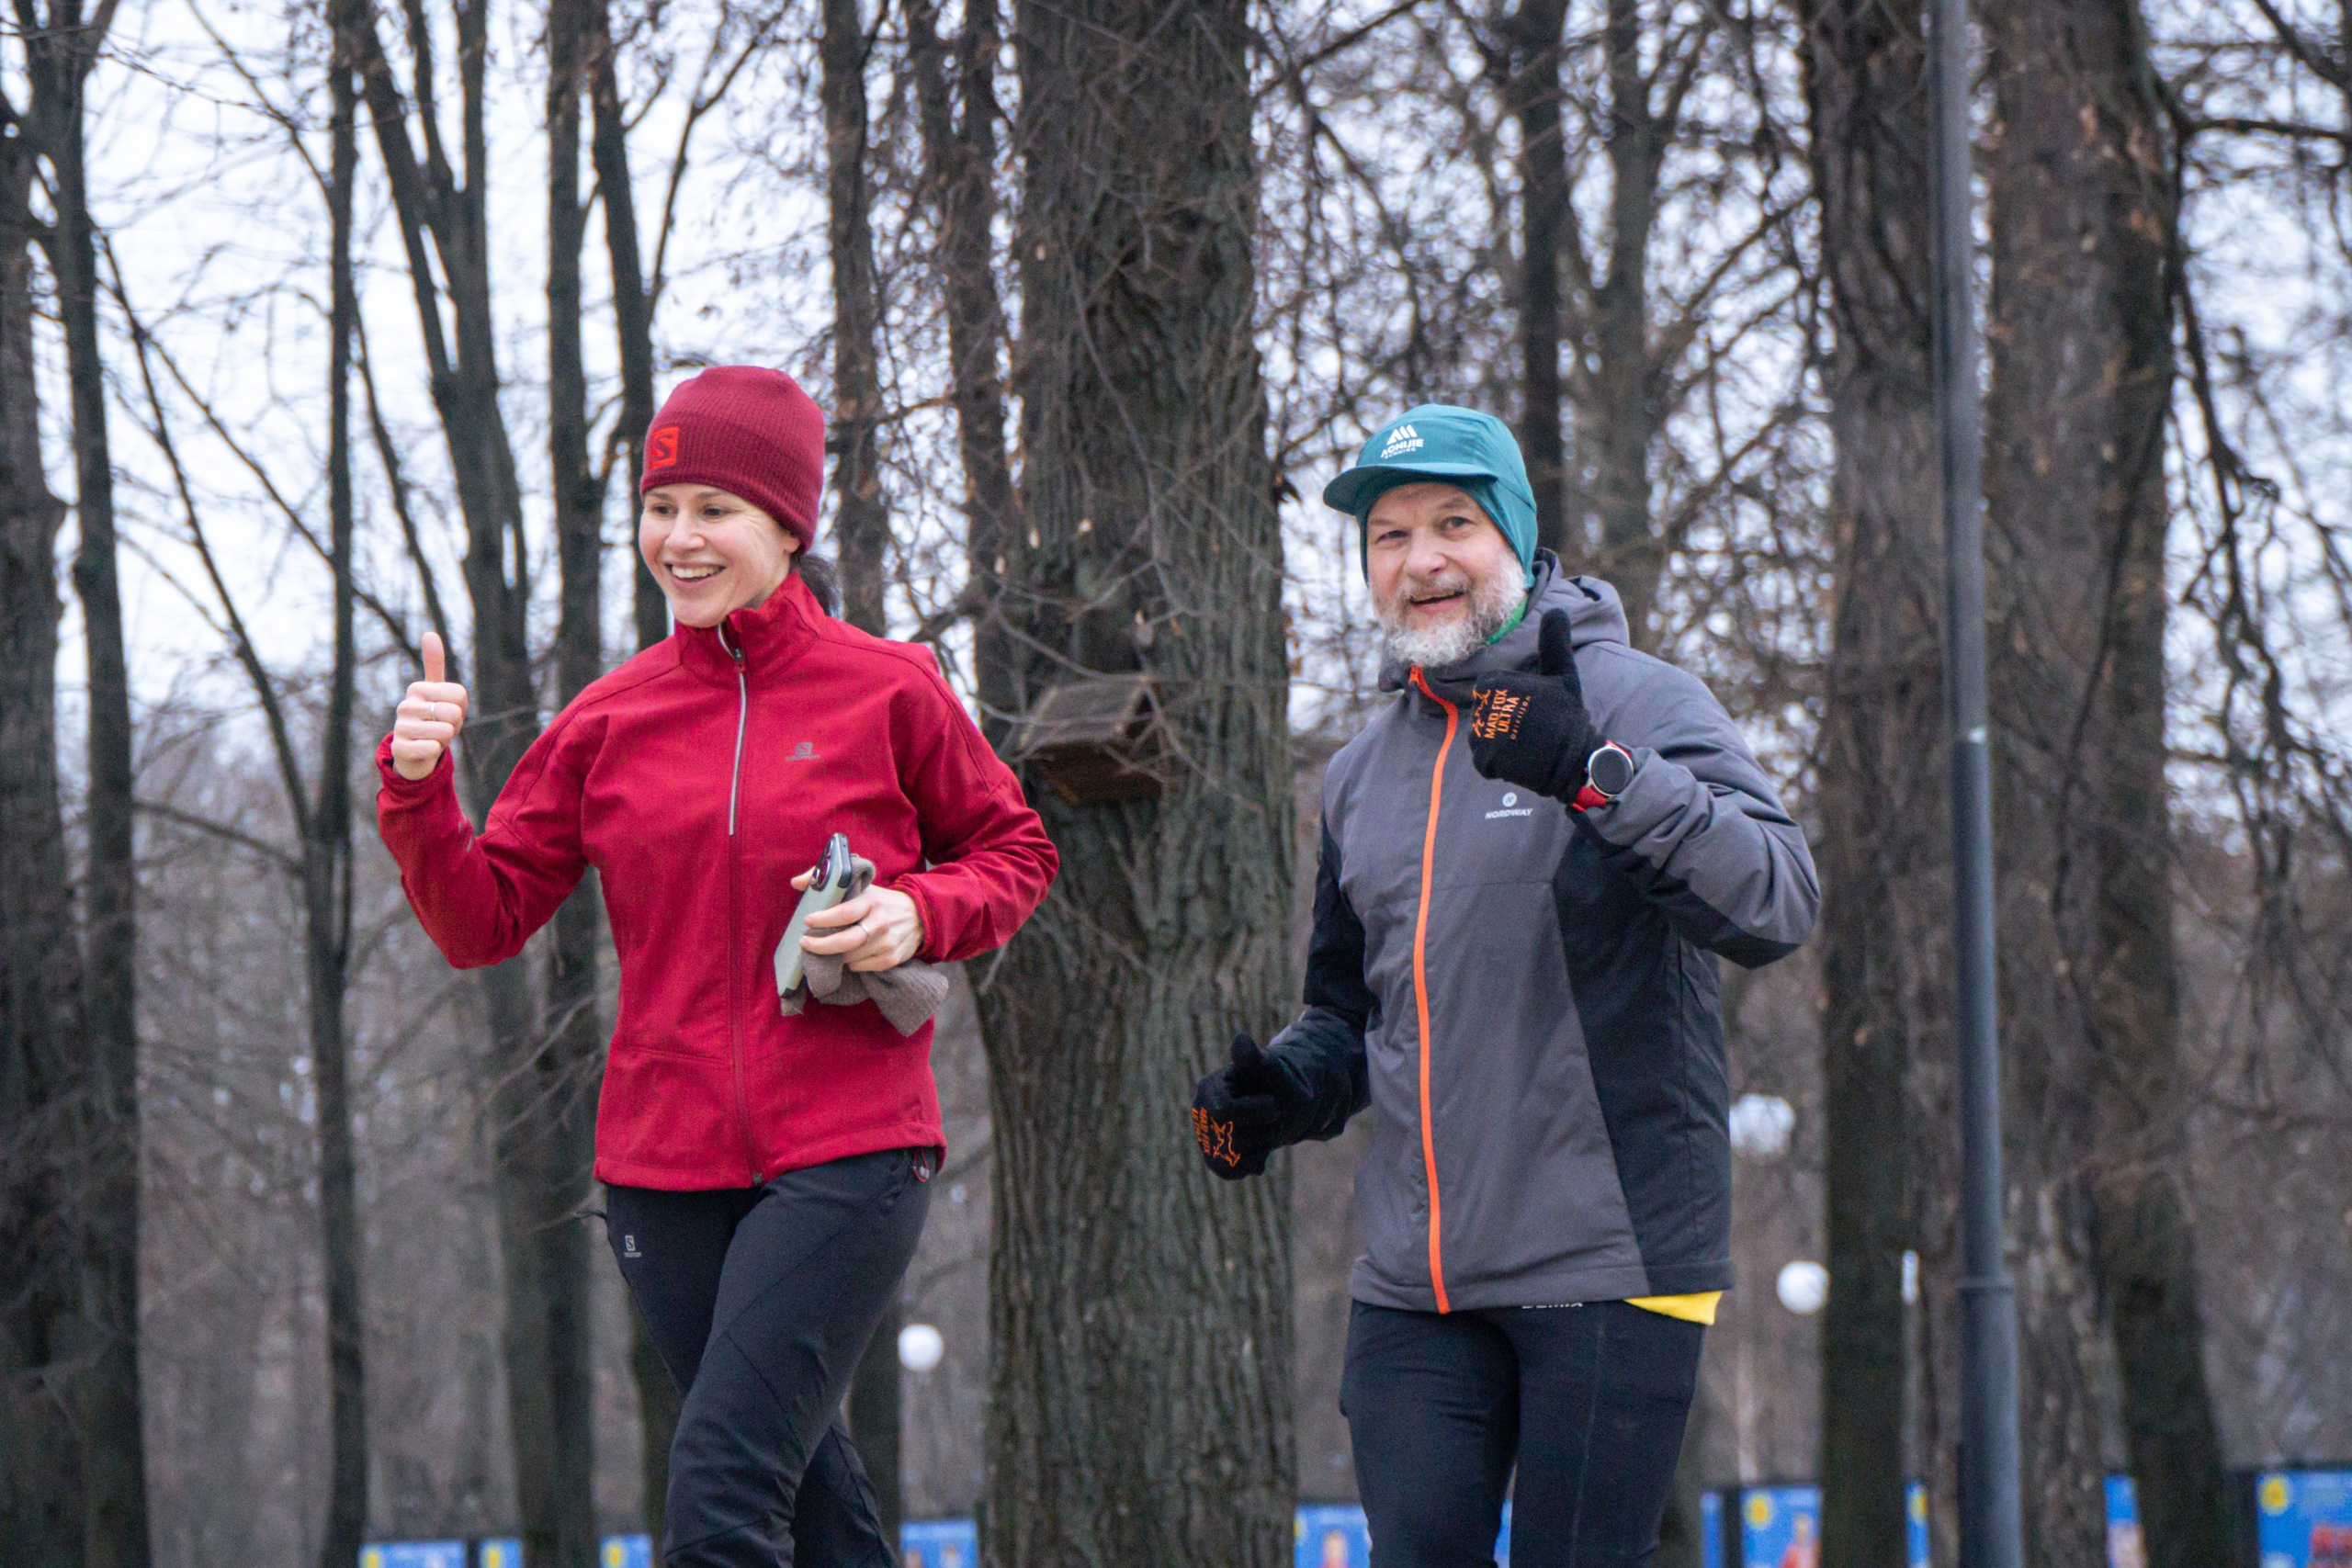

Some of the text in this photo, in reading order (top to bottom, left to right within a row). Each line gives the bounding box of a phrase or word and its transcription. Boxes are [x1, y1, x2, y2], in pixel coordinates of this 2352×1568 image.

[652, 434, 673, 461] S
[1380, 438, 1424, 458] AONIJIE
[1484, 689, 1509, 739] MAD FOX
[1497, 696, 1521, 732] ULTRA
[1484, 808, 1533, 819] NORDWAY
